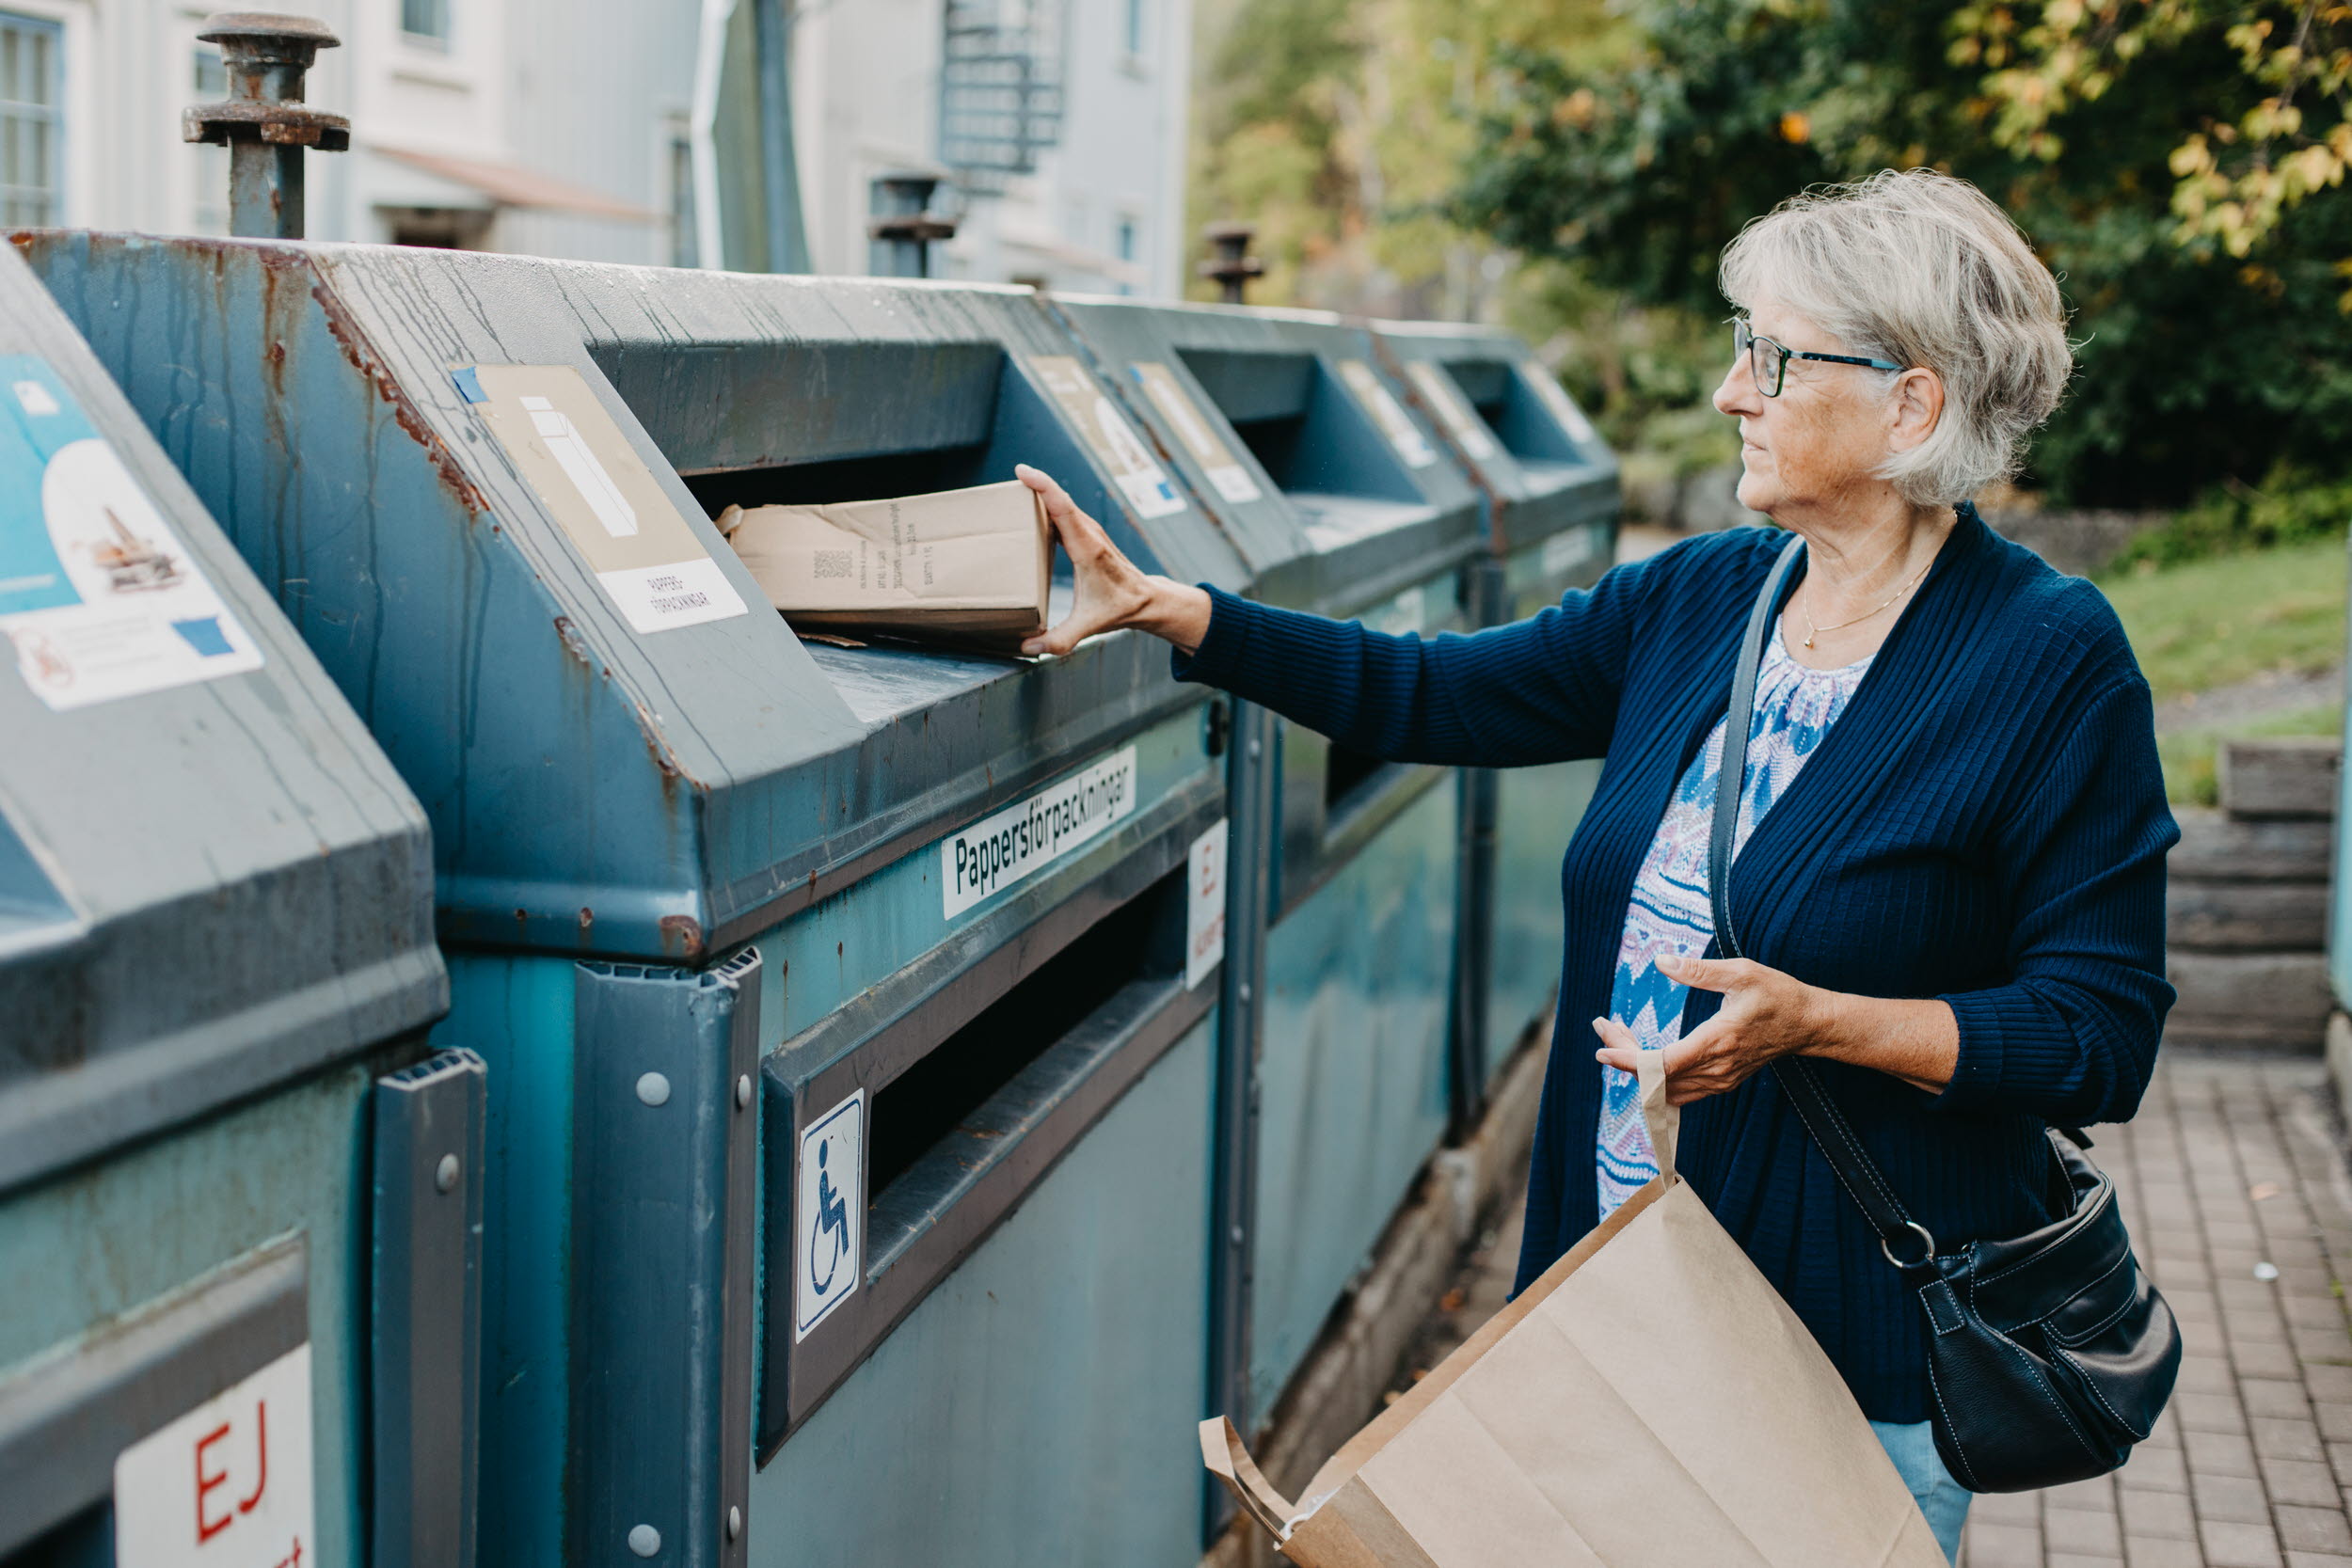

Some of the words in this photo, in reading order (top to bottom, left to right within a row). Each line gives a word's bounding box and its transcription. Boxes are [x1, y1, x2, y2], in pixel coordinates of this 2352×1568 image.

[647, 576, 683, 594] PAPPERS-
[955, 766, 1127, 895] Pappersförpackningar
[195, 1399, 266, 1545] EJ
